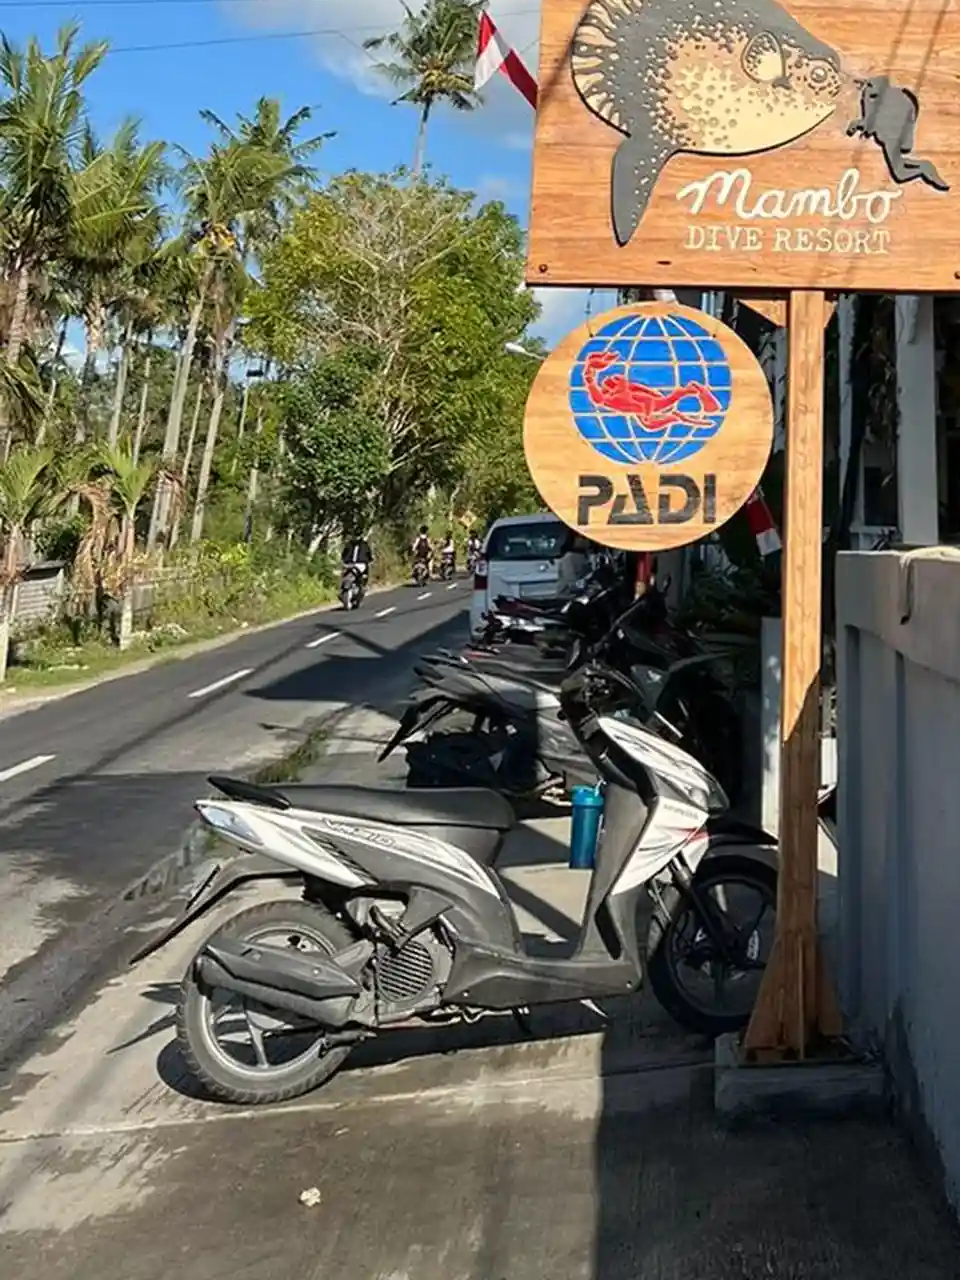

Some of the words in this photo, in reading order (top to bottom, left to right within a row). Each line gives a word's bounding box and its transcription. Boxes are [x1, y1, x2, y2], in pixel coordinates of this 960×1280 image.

[676, 167, 903, 224] Mambo
[684, 225, 763, 252] DIVE
[772, 227, 890, 254] RESORT
[577, 473, 716, 525] PADI
